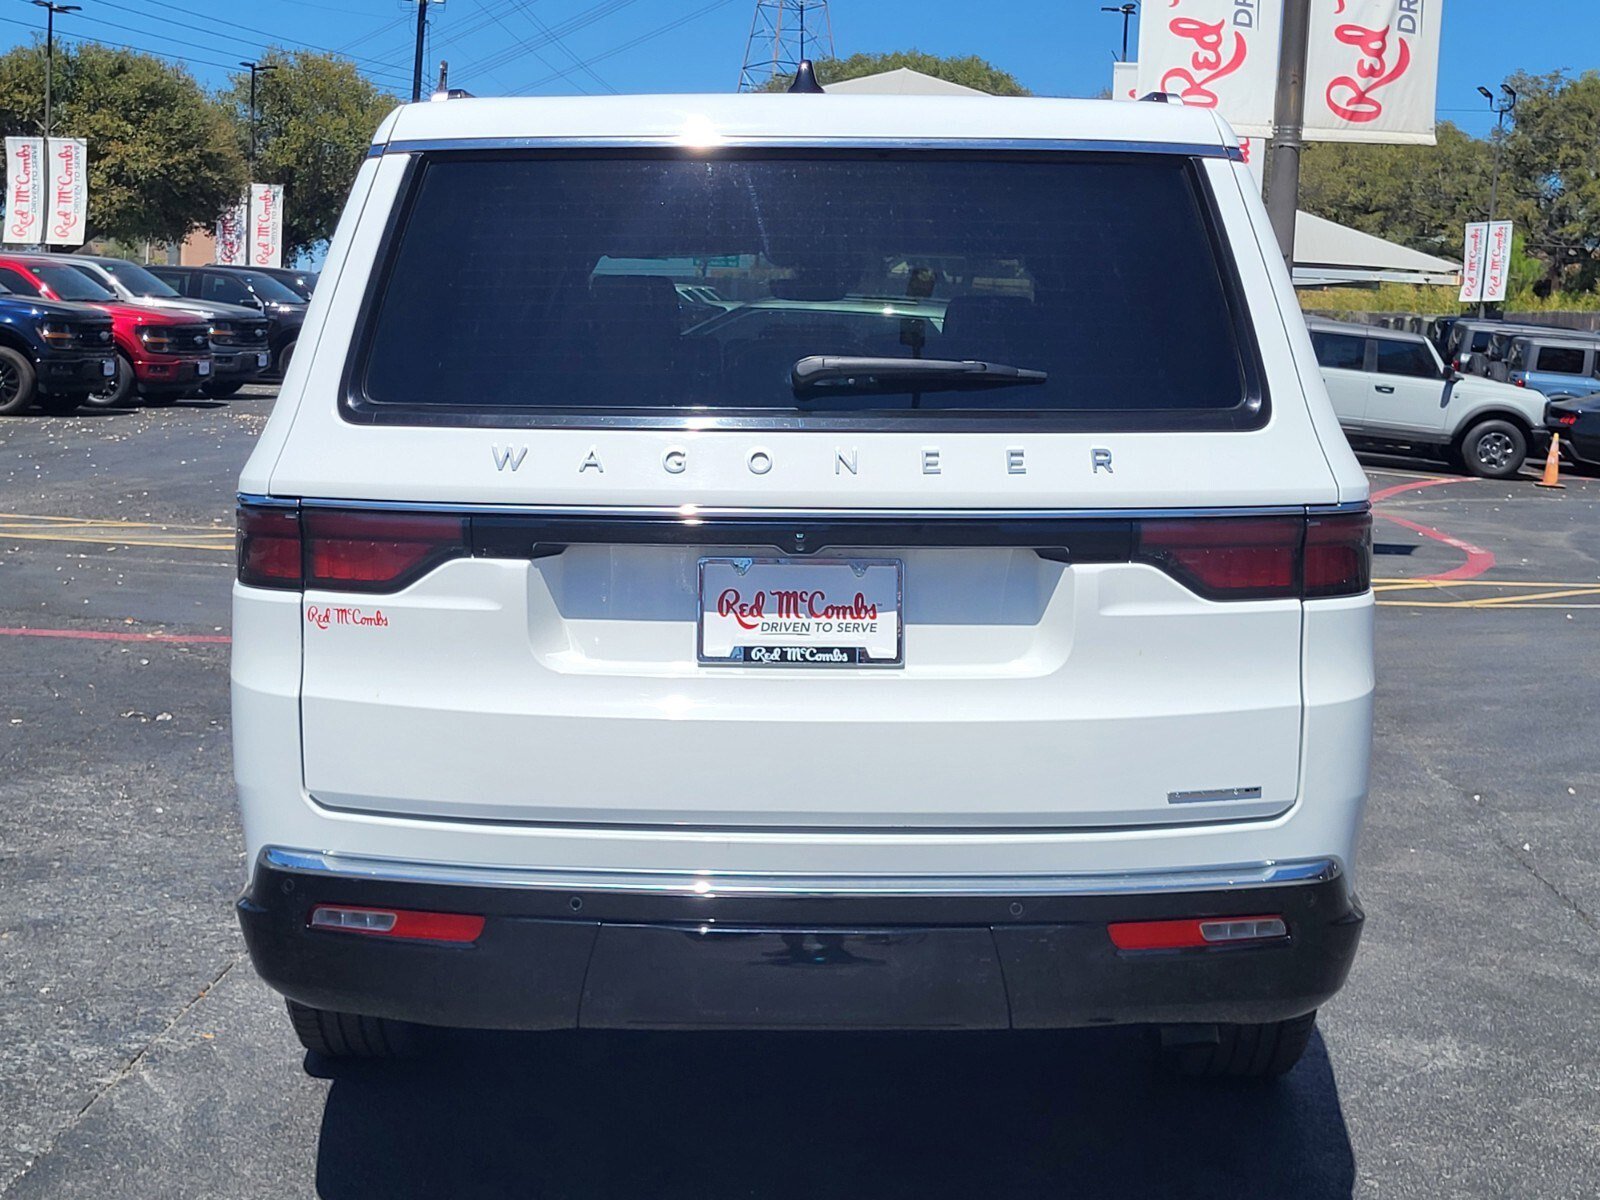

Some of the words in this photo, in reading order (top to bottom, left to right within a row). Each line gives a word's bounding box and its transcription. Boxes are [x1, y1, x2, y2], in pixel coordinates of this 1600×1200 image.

[1160, 18, 1246, 108] Red
[1326, 24, 1411, 122] Red
[15, 144, 31, 206] McCombs
[57, 145, 73, 207] McCombs
[11, 209, 35, 237] Red
[54, 210, 77, 237] Red
[256, 242, 275, 265] Red
[491, 443, 1114, 475] WAGONEER
[307, 605, 331, 629] Red
[332, 608, 389, 627] McCombs
[717, 588, 765, 630] Red
[769, 589, 878, 621] McCombs
[760, 622, 811, 633] DRIVEN
[815, 622, 834, 633] TO
[836, 622, 878, 633] SERVE
[751, 646, 781, 664] Red
[781, 646, 849, 663] McCombs
